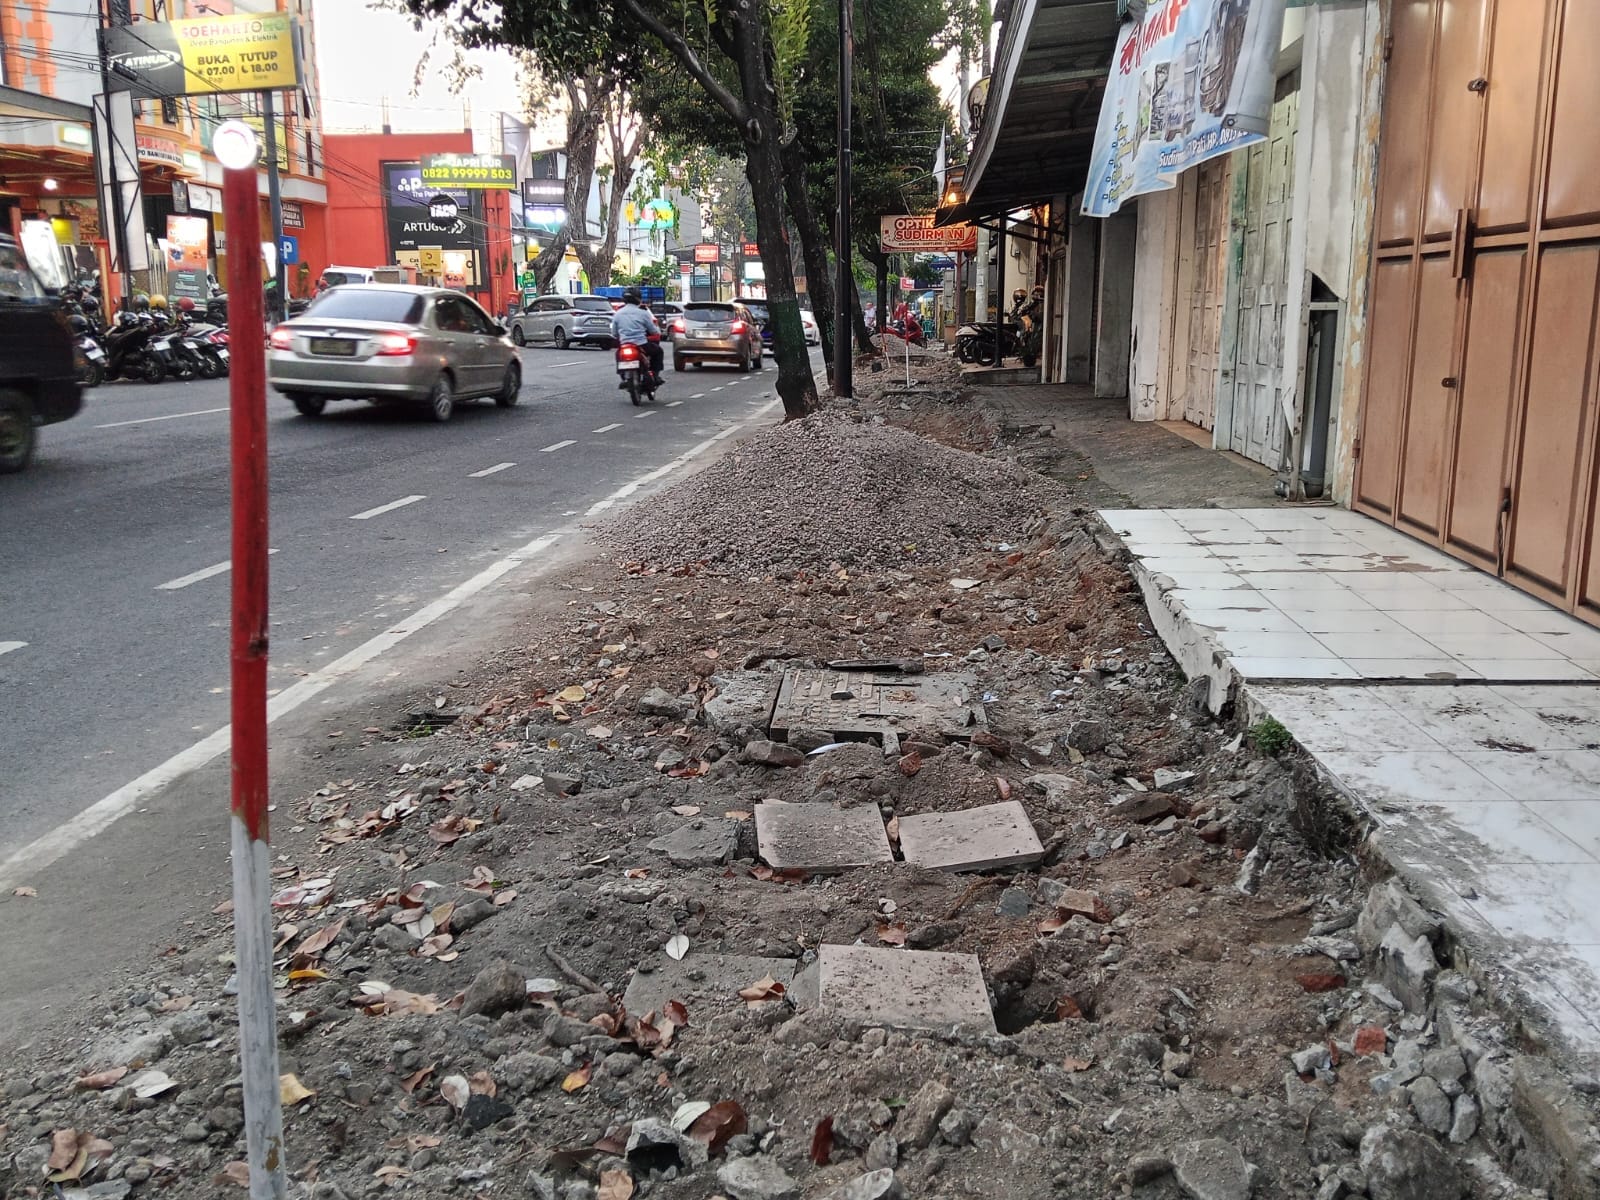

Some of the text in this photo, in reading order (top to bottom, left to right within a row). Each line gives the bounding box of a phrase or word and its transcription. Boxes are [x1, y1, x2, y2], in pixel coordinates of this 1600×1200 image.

[252, 34, 278, 42] Elektrik
[197, 55, 230, 66] BUKA
[239, 51, 278, 62] TUTUP
[206, 66, 235, 76] 07.00
[251, 63, 278, 73] 18.00
[422, 168, 512, 179] 0822 99999 503
[895, 217, 936, 230] OPTIK
